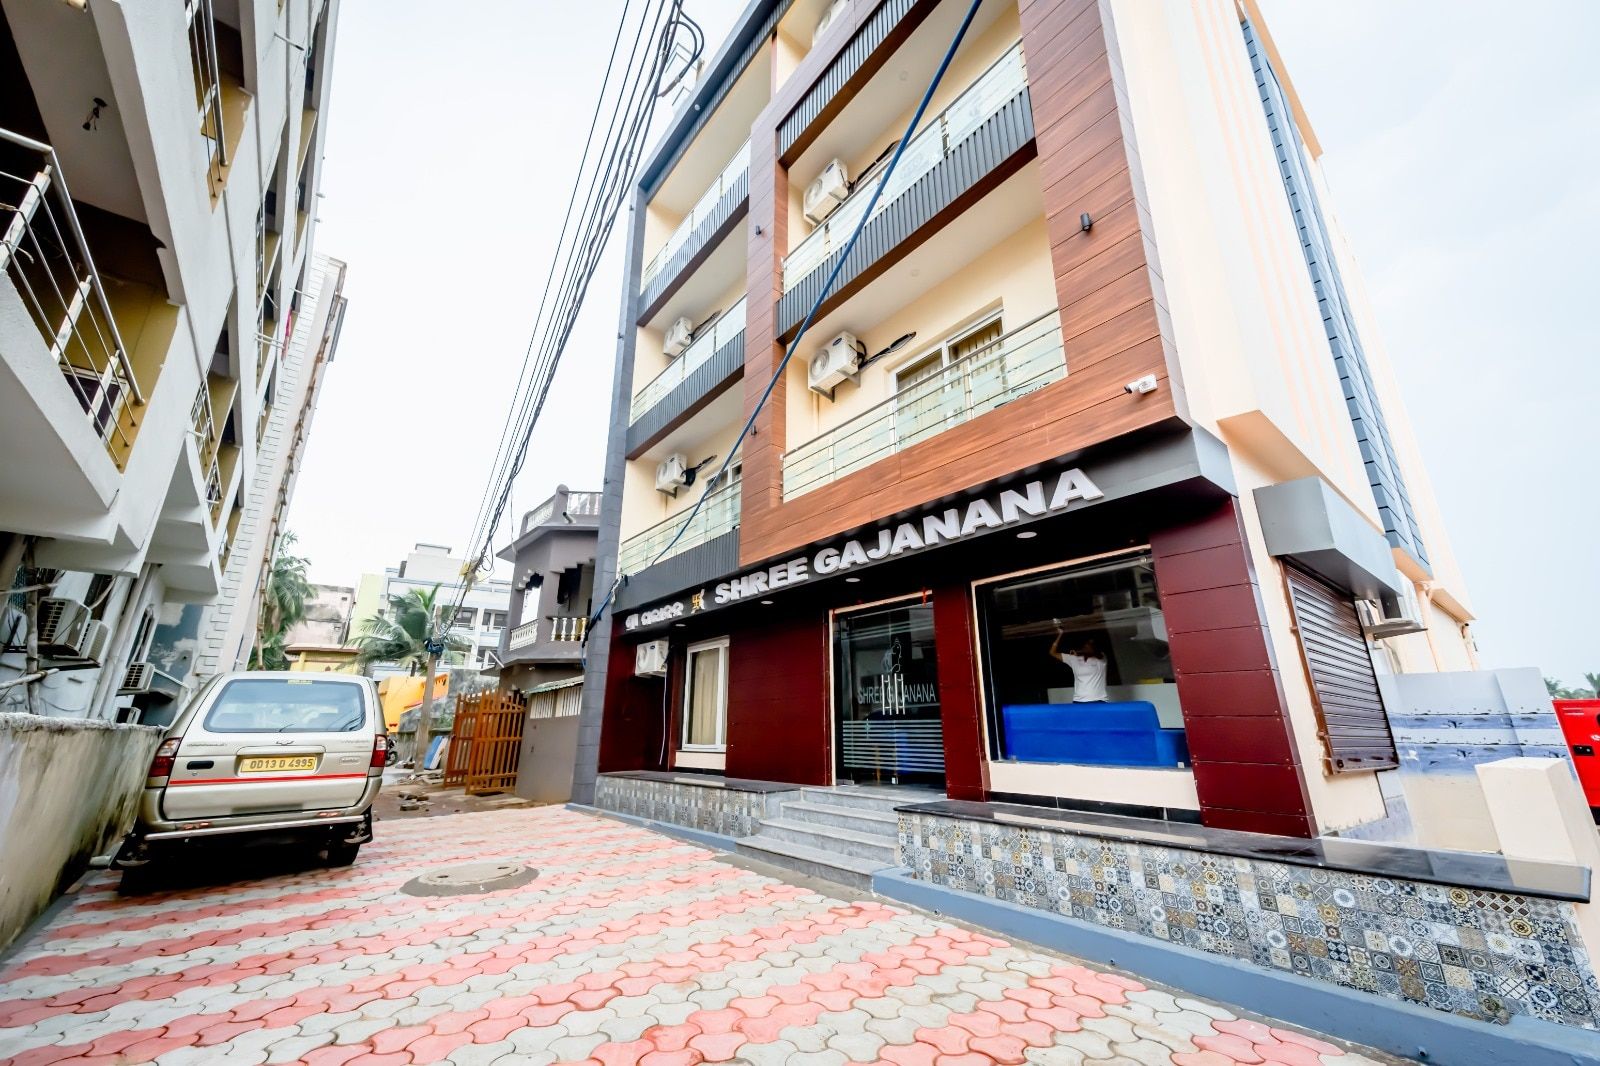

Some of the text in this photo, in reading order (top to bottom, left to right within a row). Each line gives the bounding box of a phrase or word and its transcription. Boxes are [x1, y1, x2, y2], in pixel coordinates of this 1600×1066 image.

[714, 467, 1105, 605] SHREE GAJANANA
[249, 759, 277, 770] OD13
[288, 758, 314, 769] 4995
